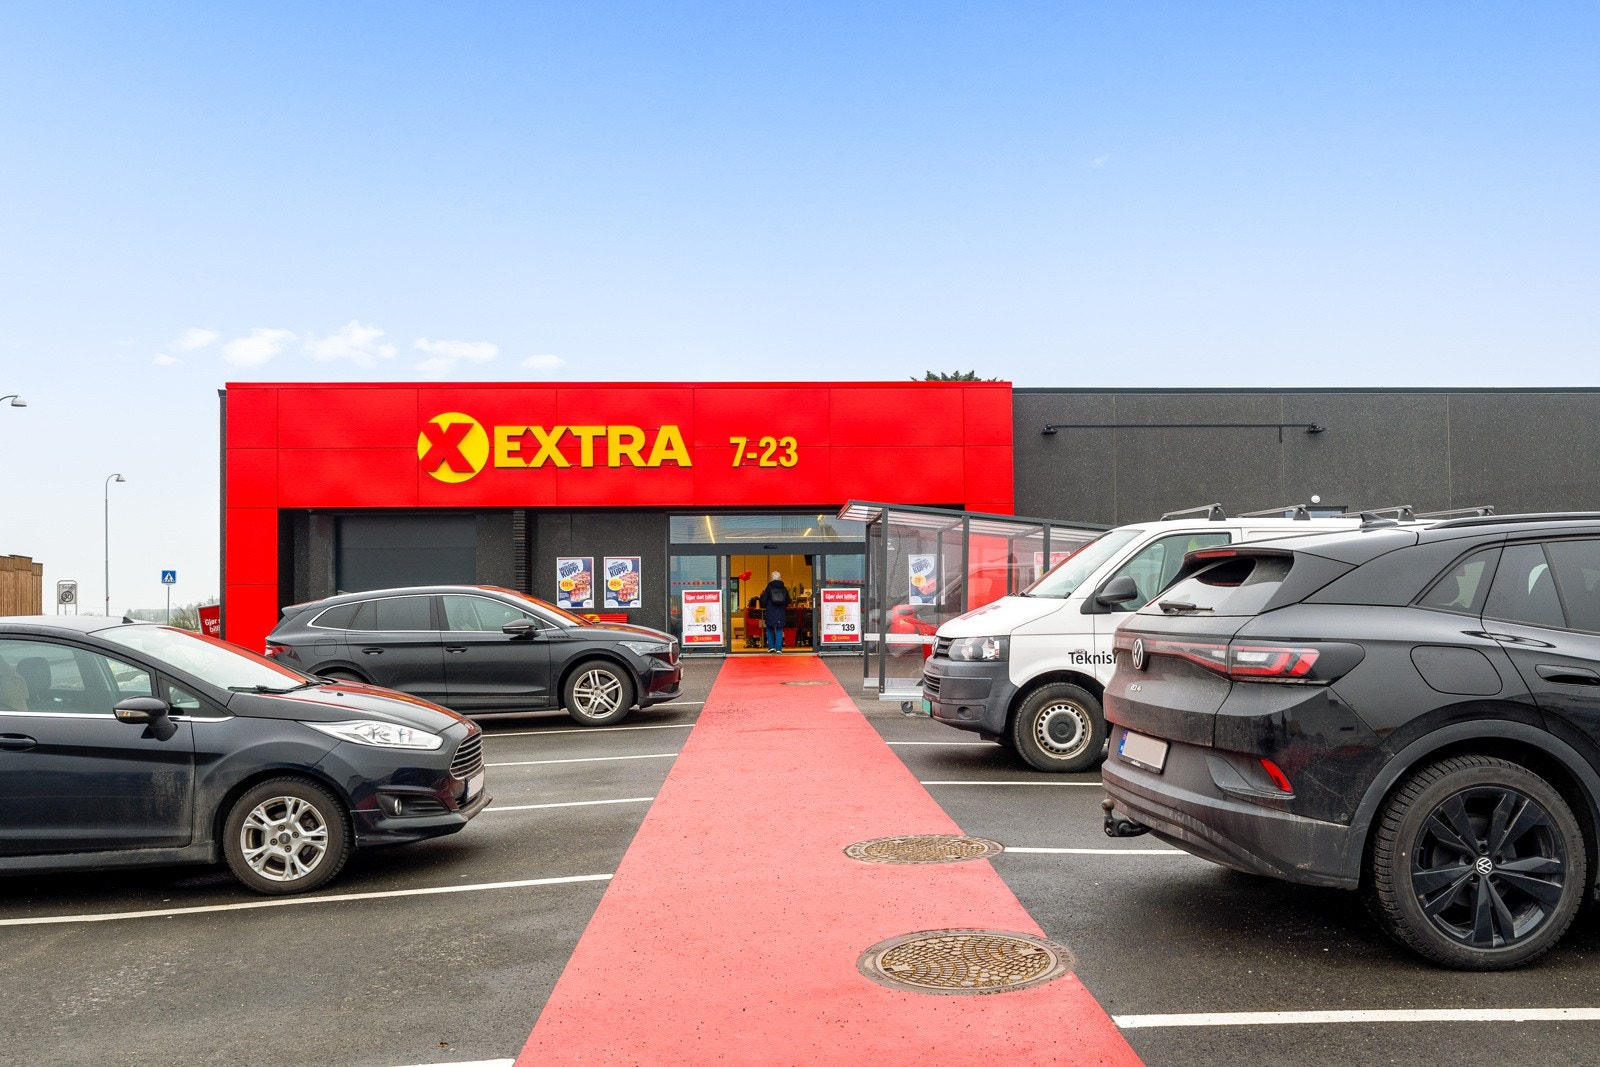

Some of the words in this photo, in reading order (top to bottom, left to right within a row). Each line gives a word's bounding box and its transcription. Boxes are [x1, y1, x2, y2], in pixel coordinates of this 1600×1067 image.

[494, 425, 692, 468] EXTRA
[729, 436, 799, 468] 7-23
[561, 565, 580, 578] KUPP!
[609, 565, 629, 577] KUPP!
[703, 624, 717, 632] 139
[1068, 651, 1116, 664] Teknis
